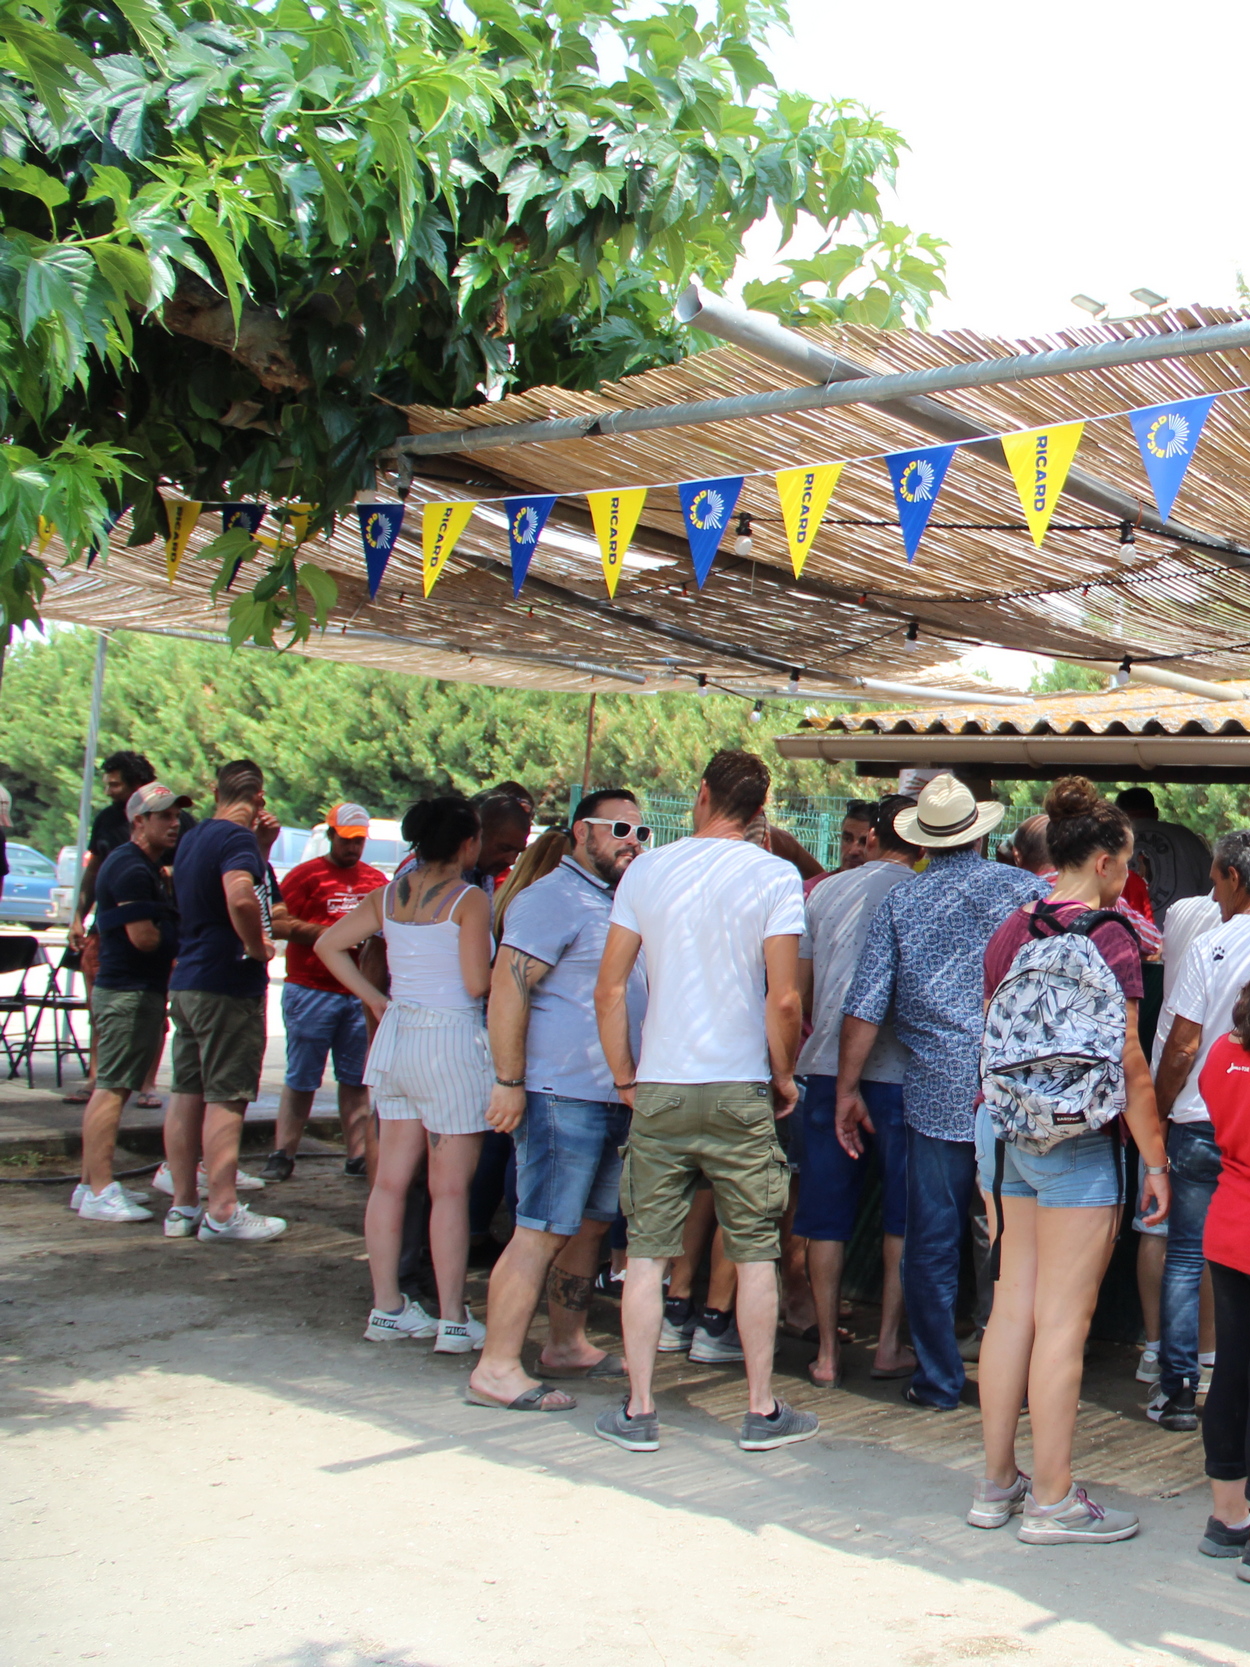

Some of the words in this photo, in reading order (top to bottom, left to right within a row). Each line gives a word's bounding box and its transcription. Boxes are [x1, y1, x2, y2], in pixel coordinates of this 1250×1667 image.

[1146, 415, 1167, 458] RICARD
[899, 461, 917, 502] RICARD
[1034, 435, 1048, 511] RICARD
[366, 513, 378, 548] RICARD
[512, 507, 527, 544] RICARD
[608, 497, 619, 565] RICARD
[689, 489, 707, 529] RICARD
[796, 473, 815, 543] RICARD
[171, 506, 183, 562] RICARD
[430, 507, 453, 567] RICARD
